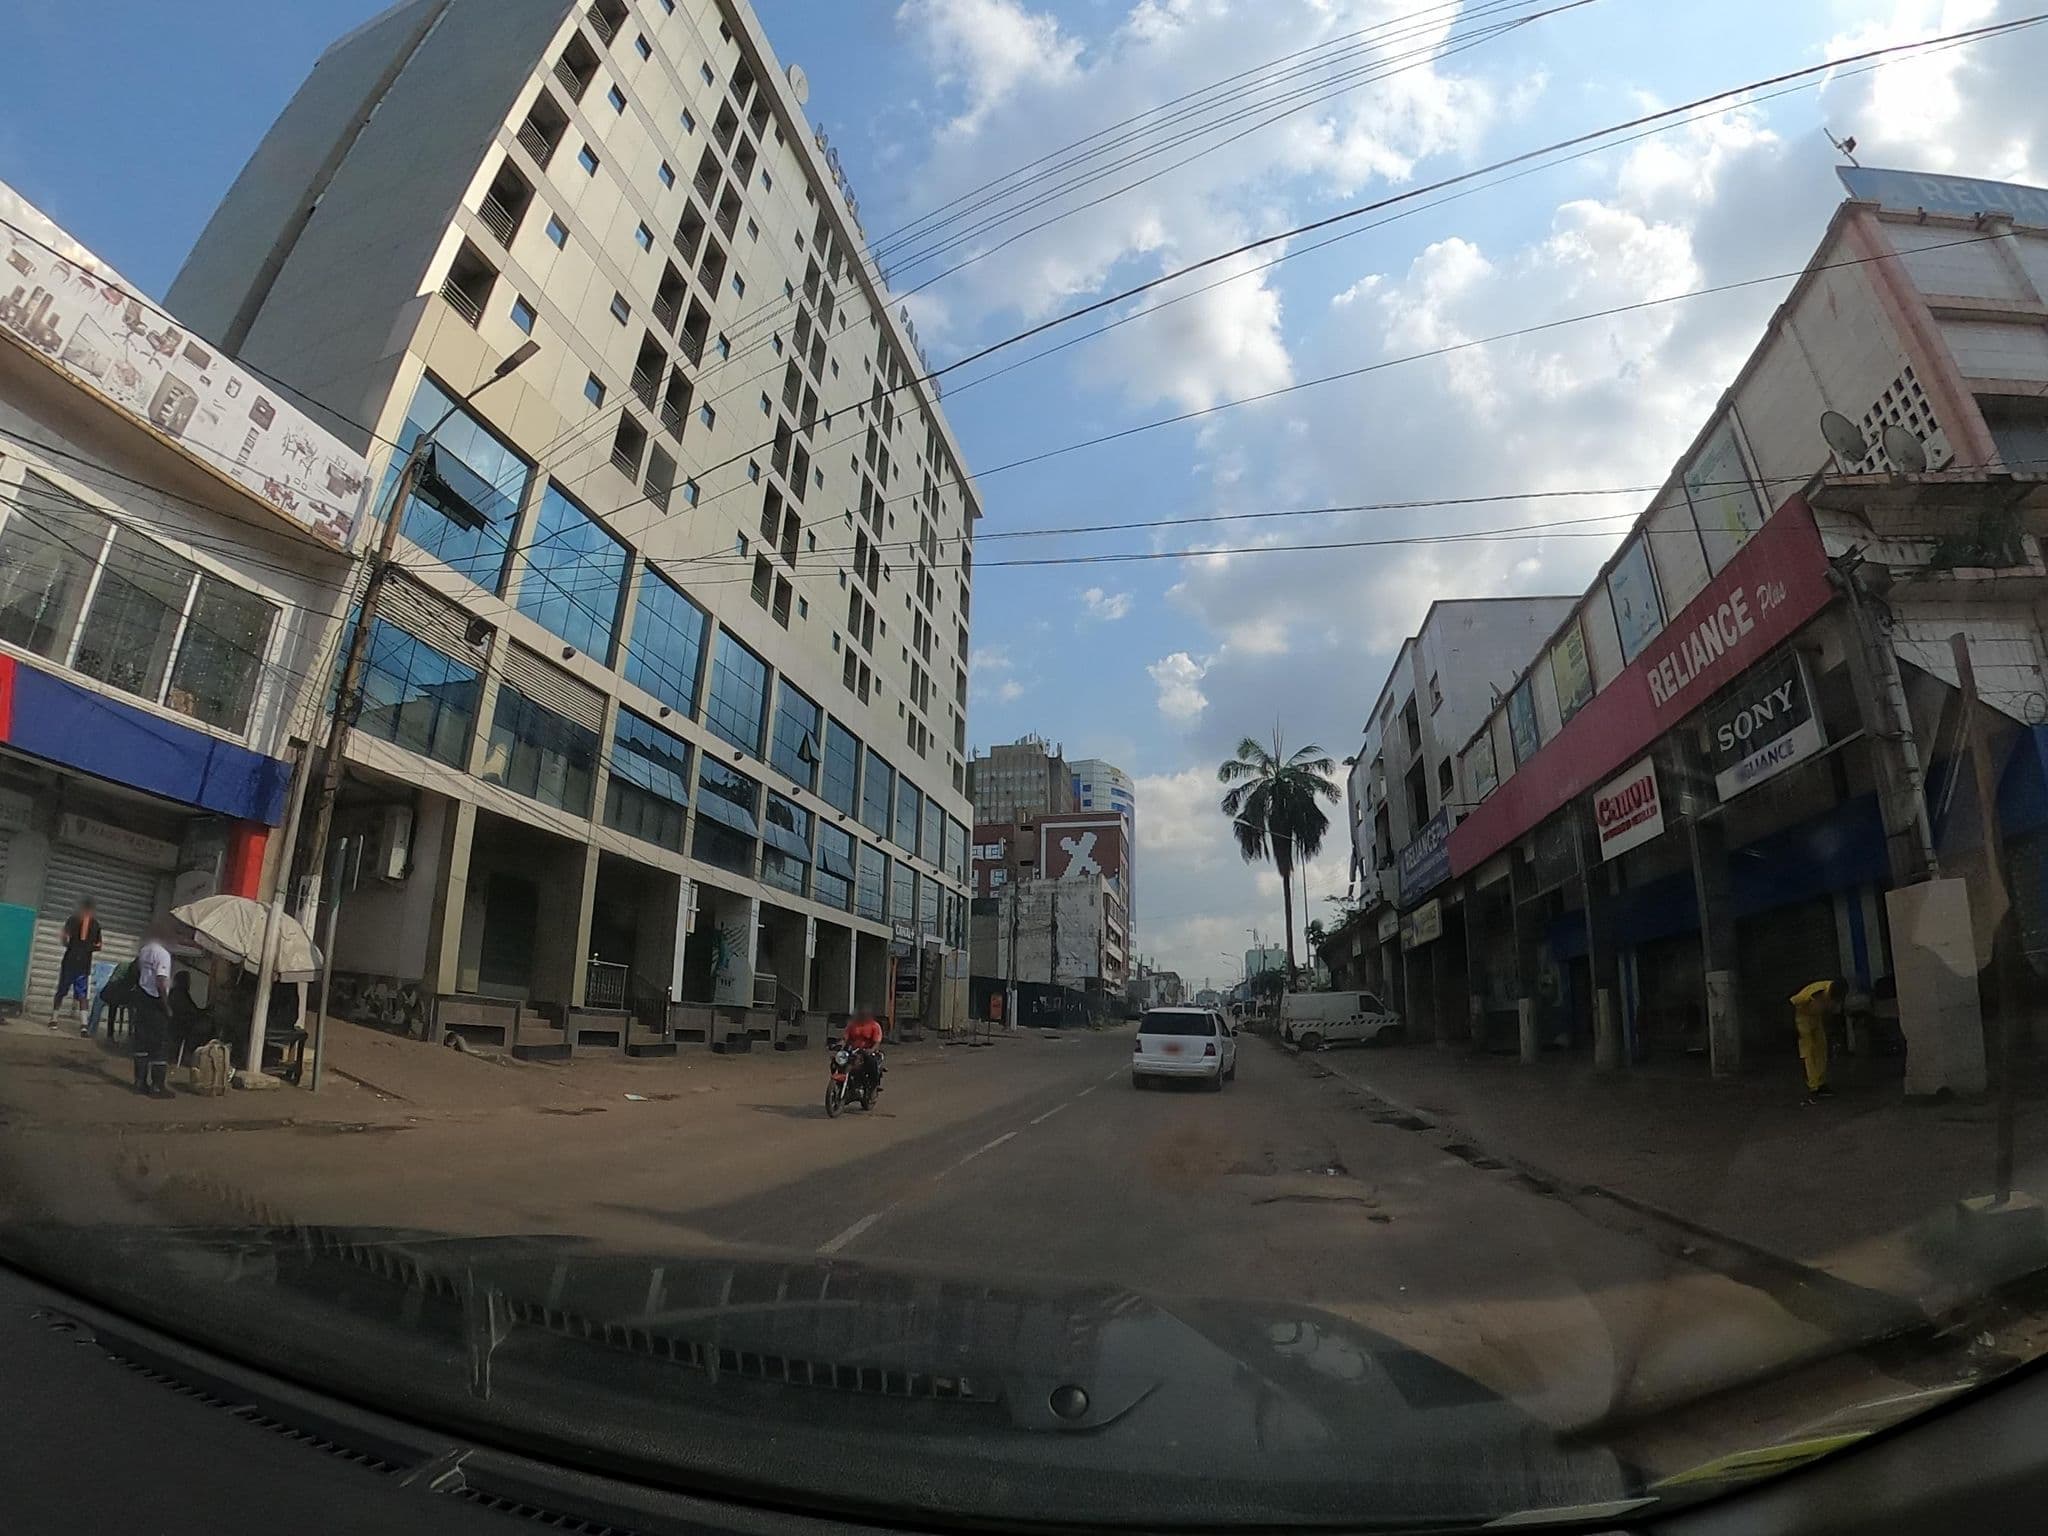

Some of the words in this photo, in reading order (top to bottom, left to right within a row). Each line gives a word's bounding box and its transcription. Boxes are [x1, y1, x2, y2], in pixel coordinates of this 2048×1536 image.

[1646, 587, 1756, 708] RELIANCE
[1756, 580, 1789, 621] Plus
[1716, 679, 1793, 753] SONY
[1736, 737, 1795, 785] ELIANCE
[1598, 775, 1656, 827] Canon
